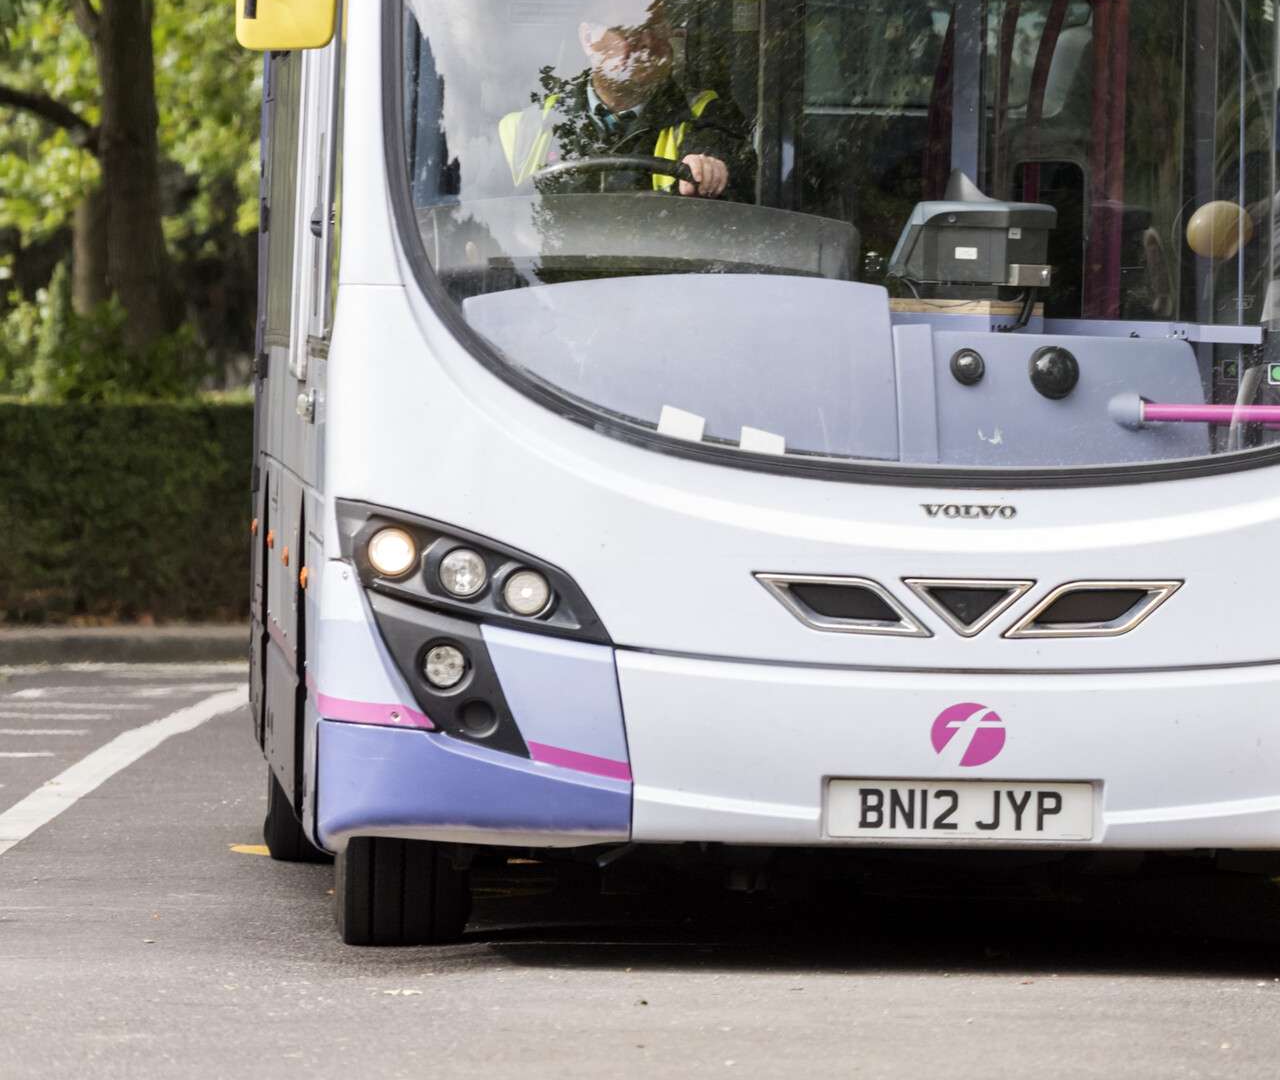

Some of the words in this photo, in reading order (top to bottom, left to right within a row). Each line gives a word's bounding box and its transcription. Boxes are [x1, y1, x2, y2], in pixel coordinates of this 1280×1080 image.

[919, 503, 1018, 520] VOLVO
[858, 787, 960, 830] BN12
[975, 789, 1063, 832] JYP
